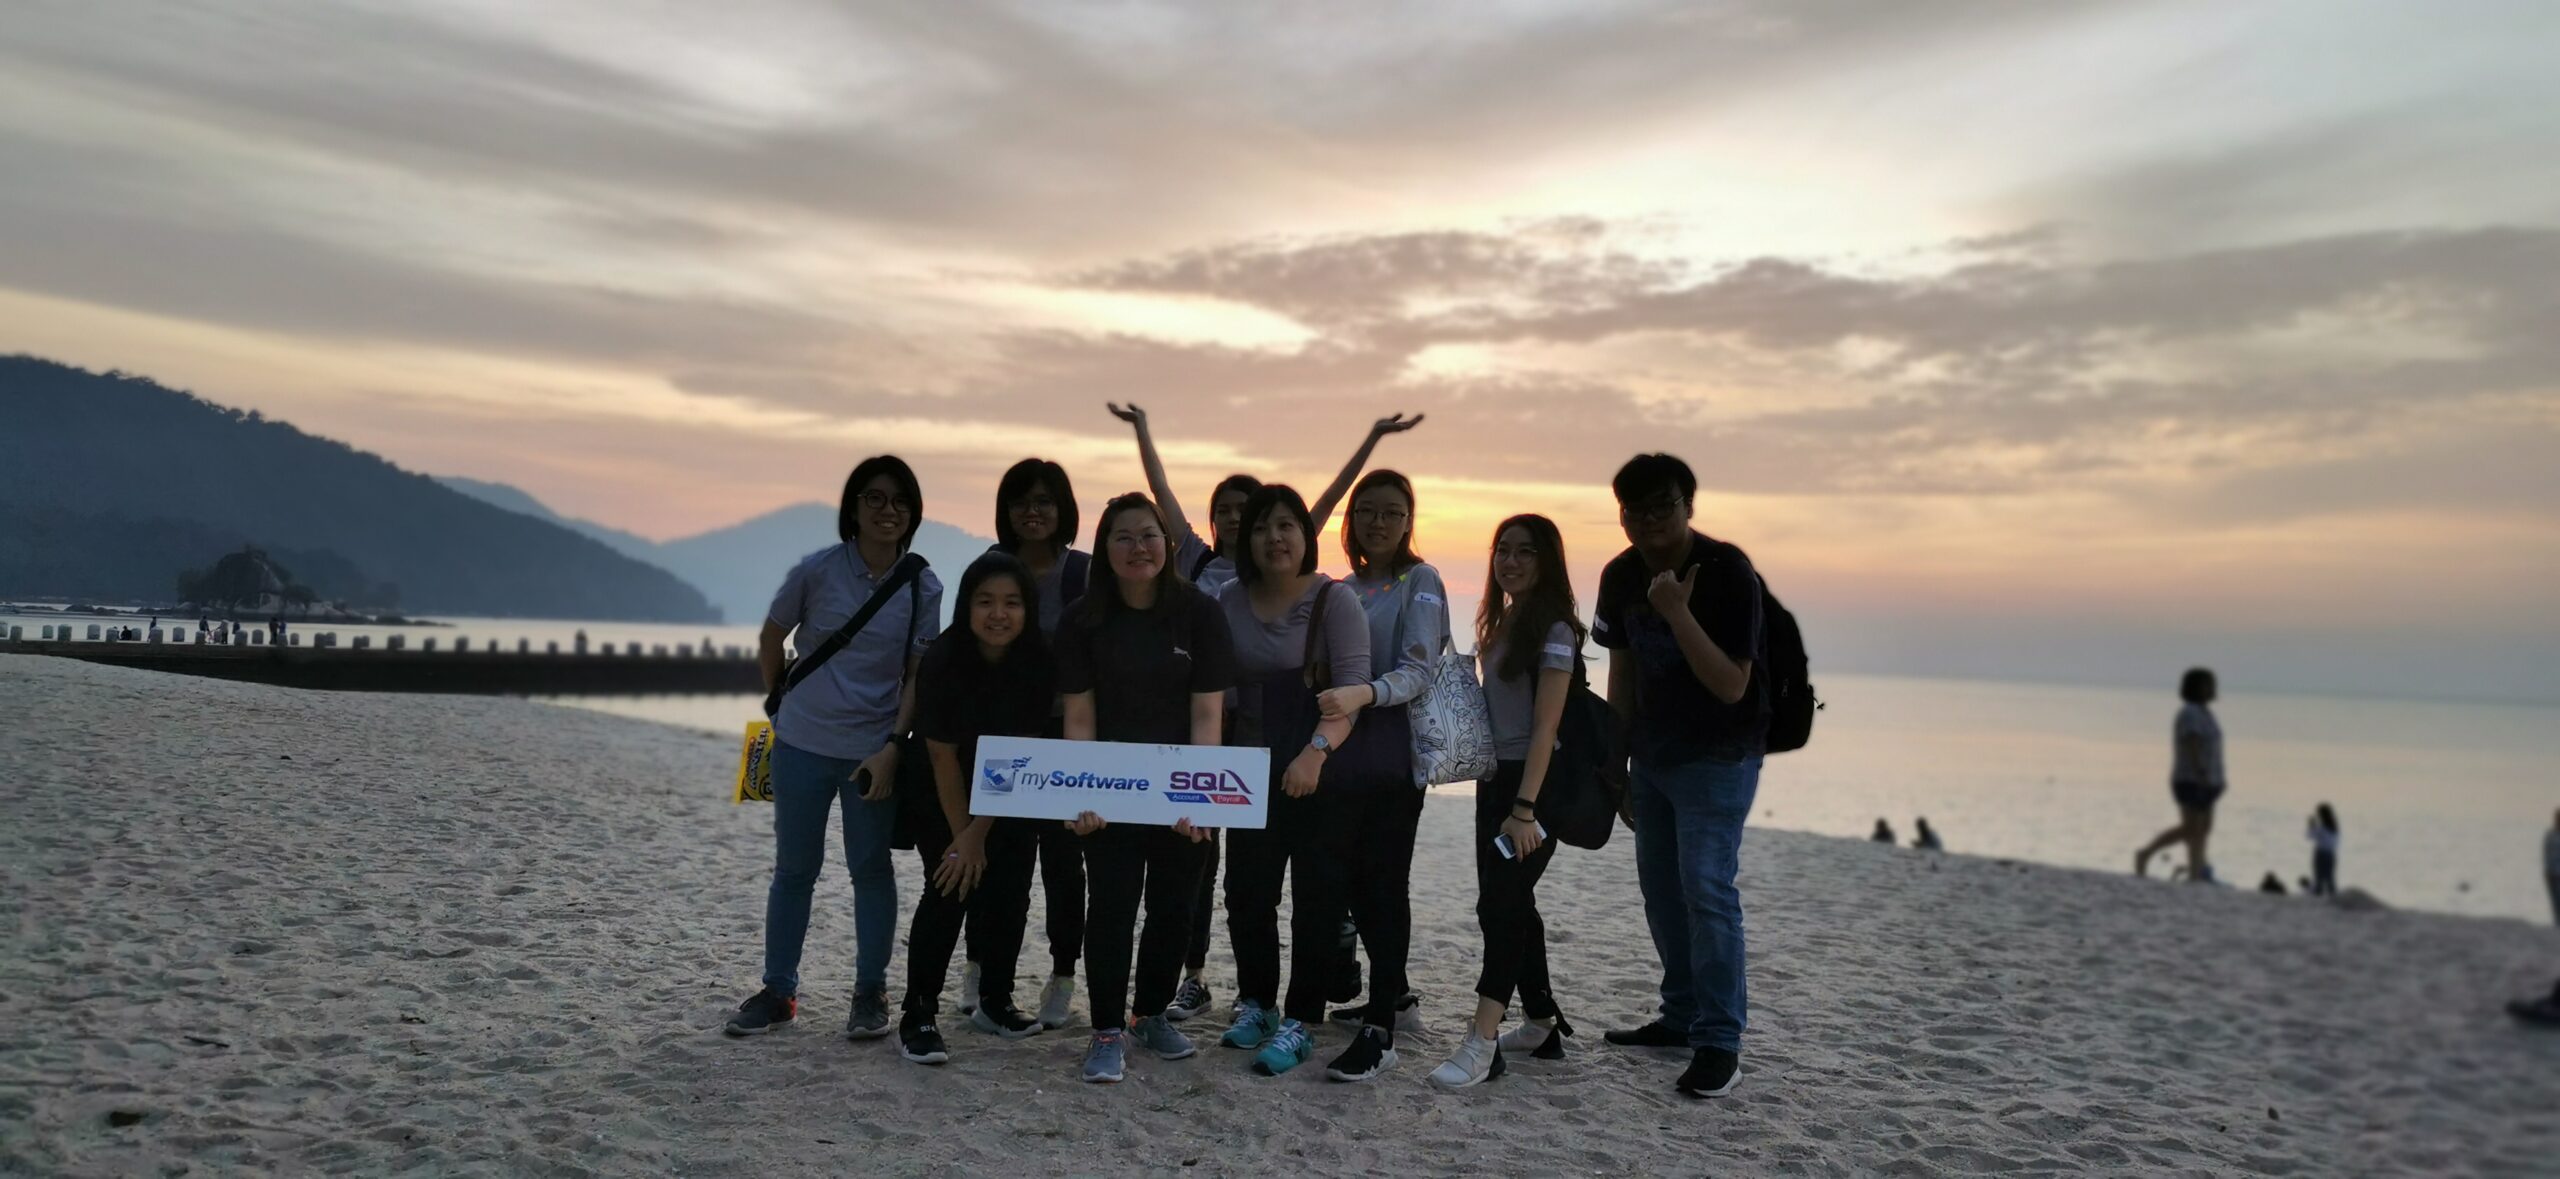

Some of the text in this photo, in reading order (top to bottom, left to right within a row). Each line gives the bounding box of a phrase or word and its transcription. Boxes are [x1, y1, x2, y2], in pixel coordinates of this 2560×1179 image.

[1021, 770, 1150, 791] mySoftware
[1170, 771, 1240, 792] SQL
[1217, 795, 1240, 803] Payr
